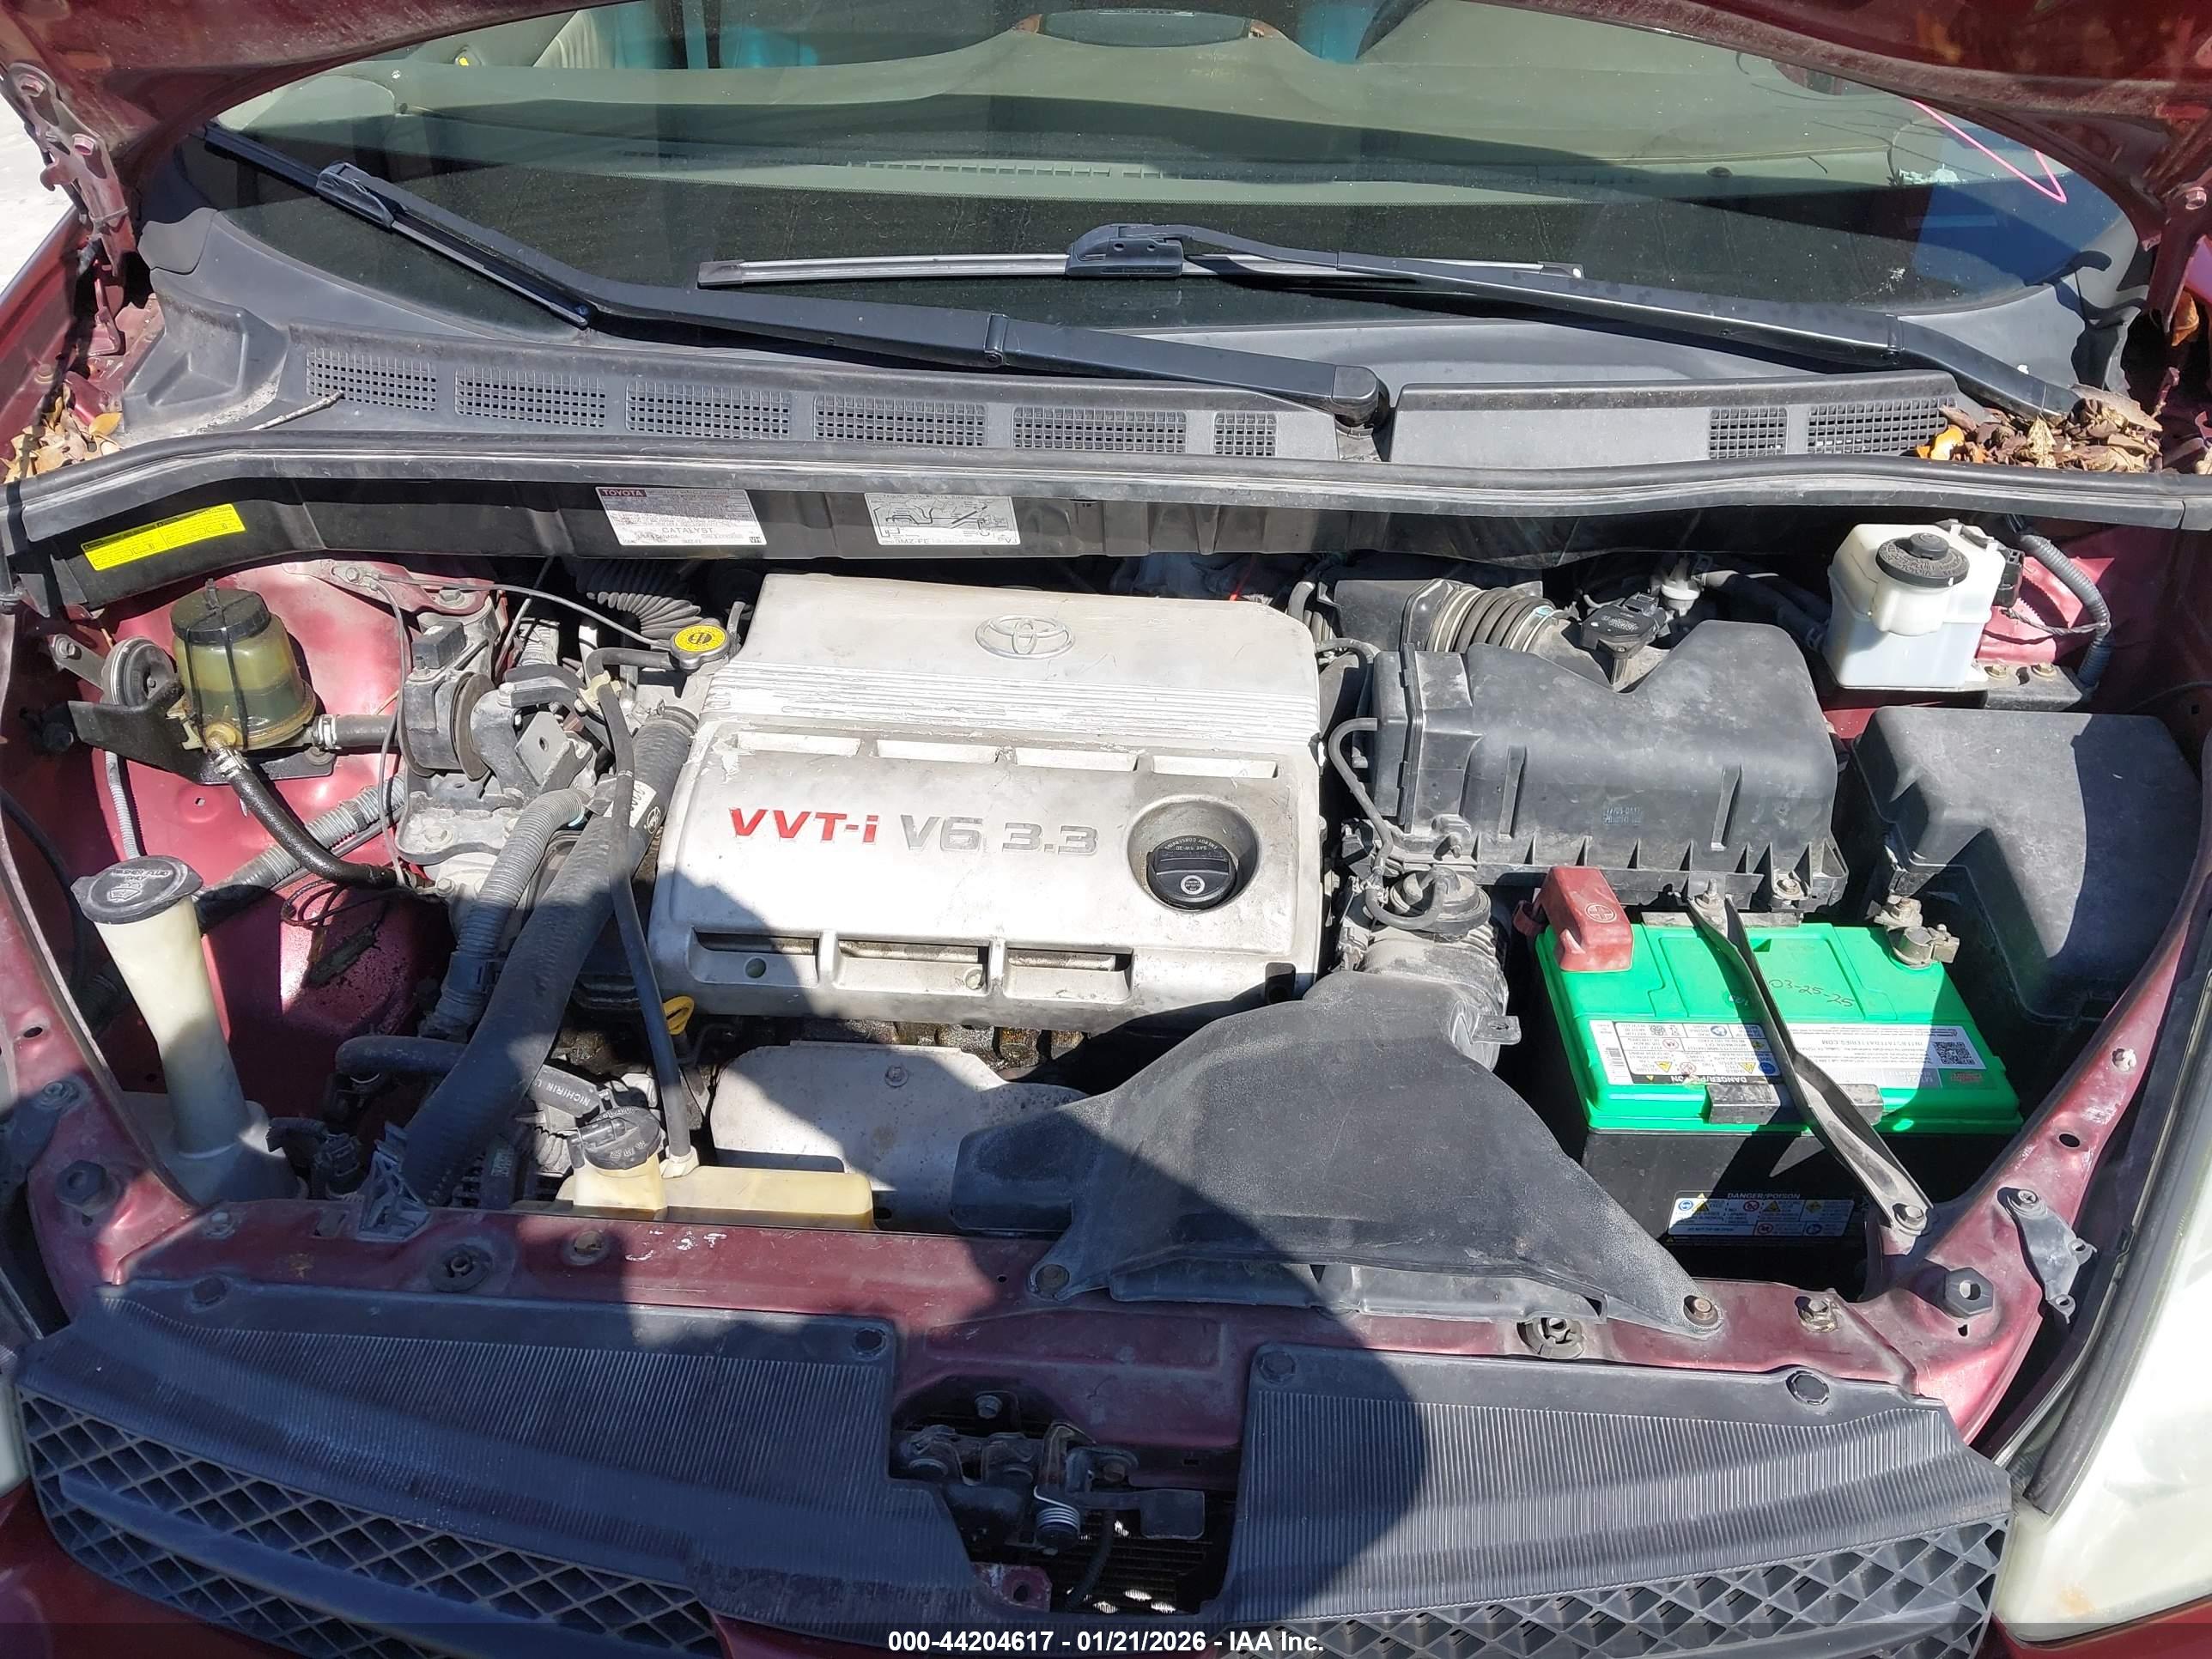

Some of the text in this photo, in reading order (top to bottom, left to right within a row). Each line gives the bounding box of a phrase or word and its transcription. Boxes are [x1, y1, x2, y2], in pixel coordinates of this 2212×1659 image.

[729, 807, 1099, 856] VVT-i V6 3.3
[1768, 979, 1856, 1008] 03-25-25
[1727, 1192, 1801, 1200] DANGER/POISON
